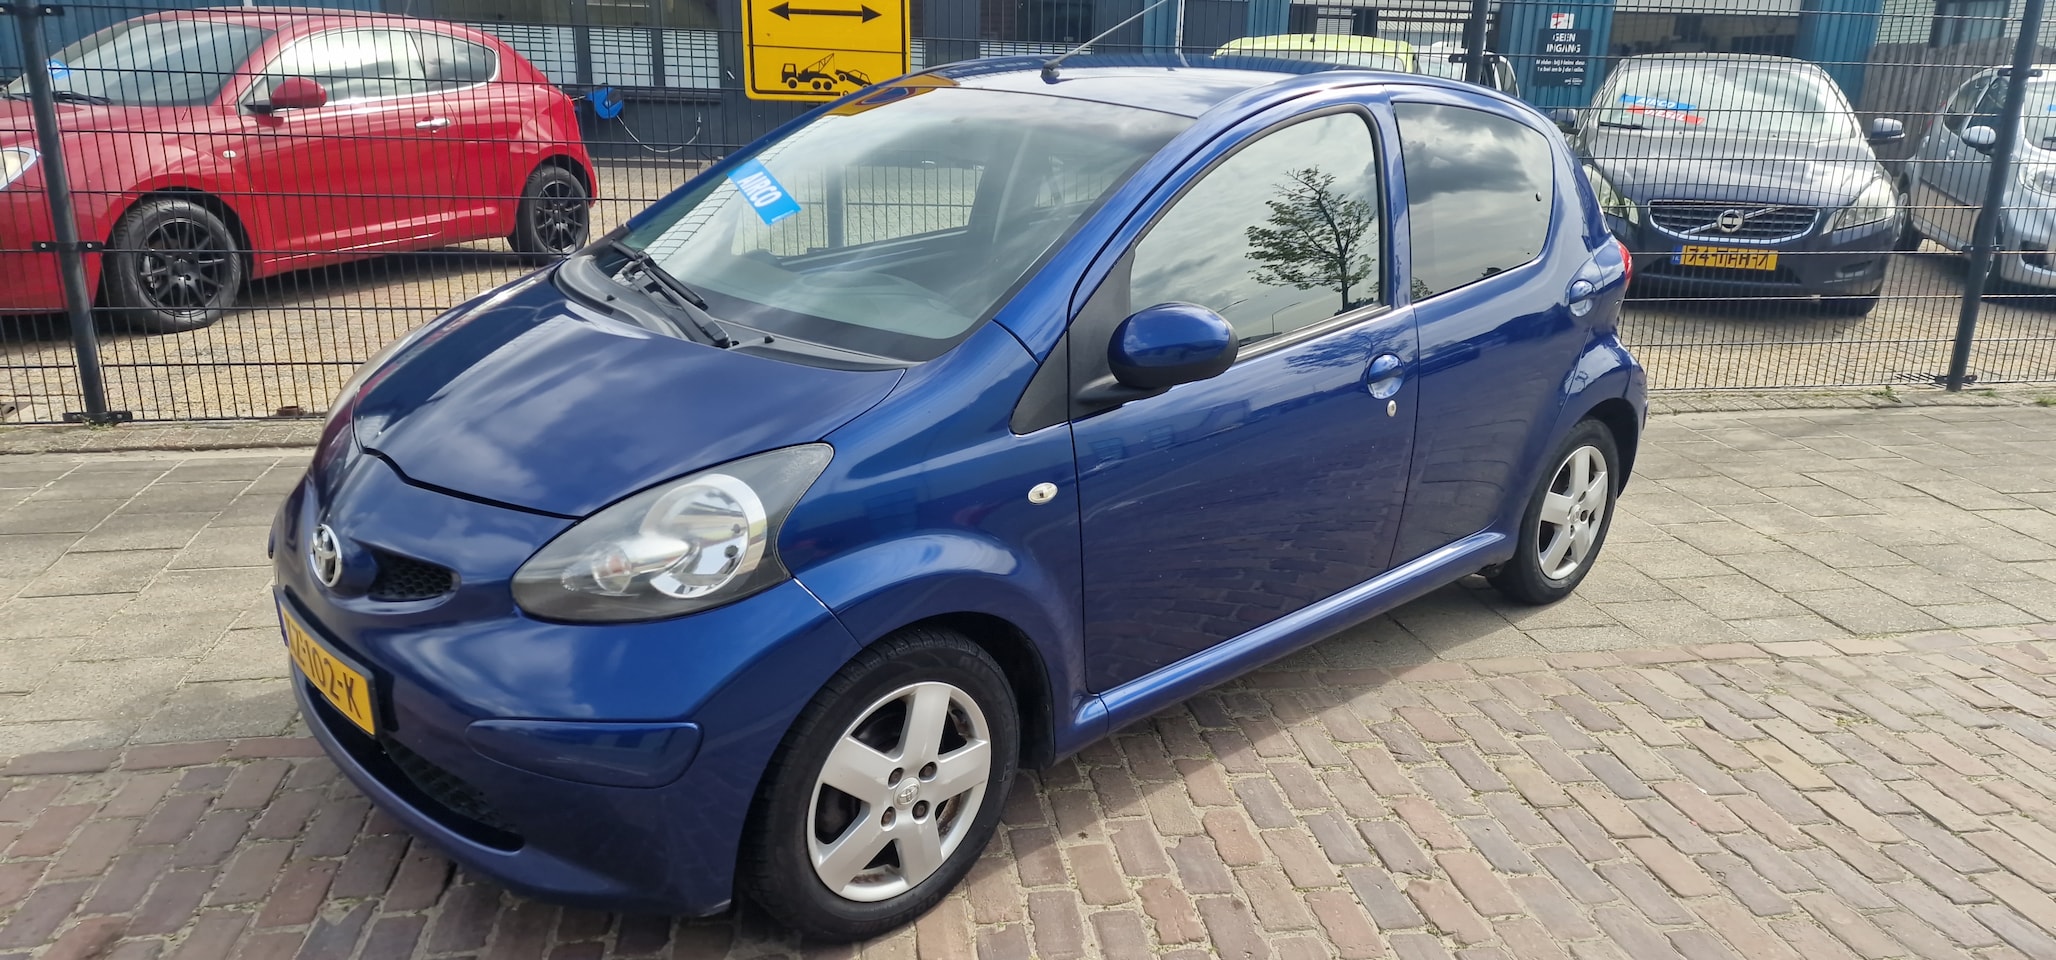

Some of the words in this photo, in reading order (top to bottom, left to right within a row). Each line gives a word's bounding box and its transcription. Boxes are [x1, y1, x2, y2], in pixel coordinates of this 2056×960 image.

[1553, 33, 1576, 42] GEEN
[1546, 43, 1581, 53] INGANG
[1636, 98, 1676, 108] AIRCO
[737, 171, 782, 208] AIRCO
